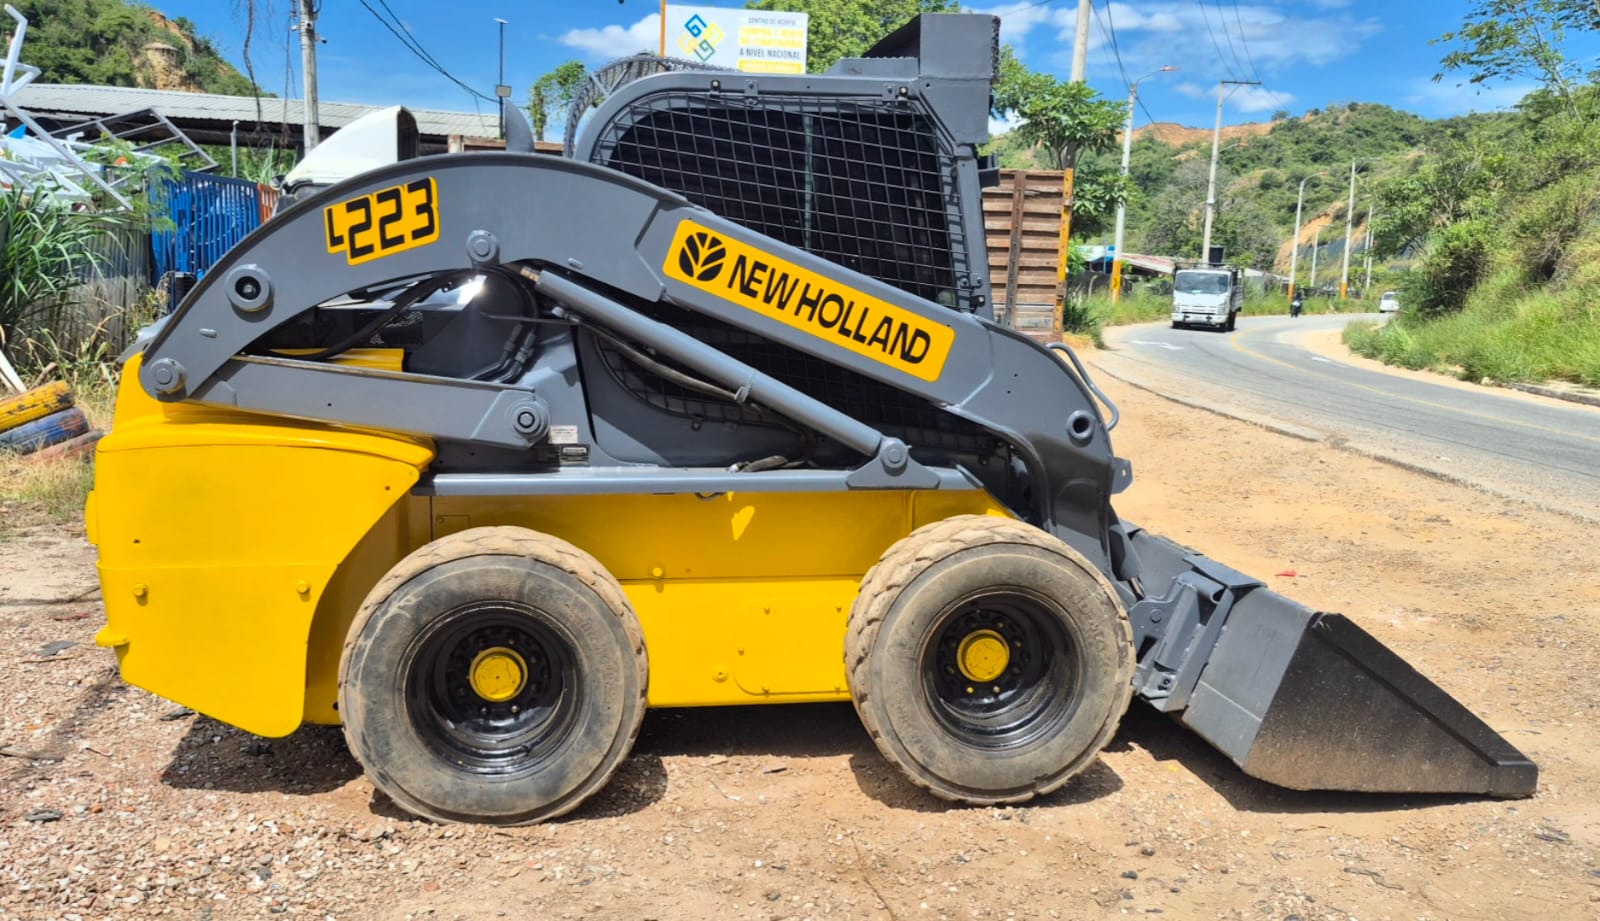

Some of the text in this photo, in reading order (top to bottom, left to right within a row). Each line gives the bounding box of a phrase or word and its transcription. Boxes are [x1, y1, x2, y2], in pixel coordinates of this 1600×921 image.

[739, 48, 800, 60] A NIVEL NACIONAL
[327, 178, 436, 259] L223
[727, 255, 932, 365] NEW HOLLAND
